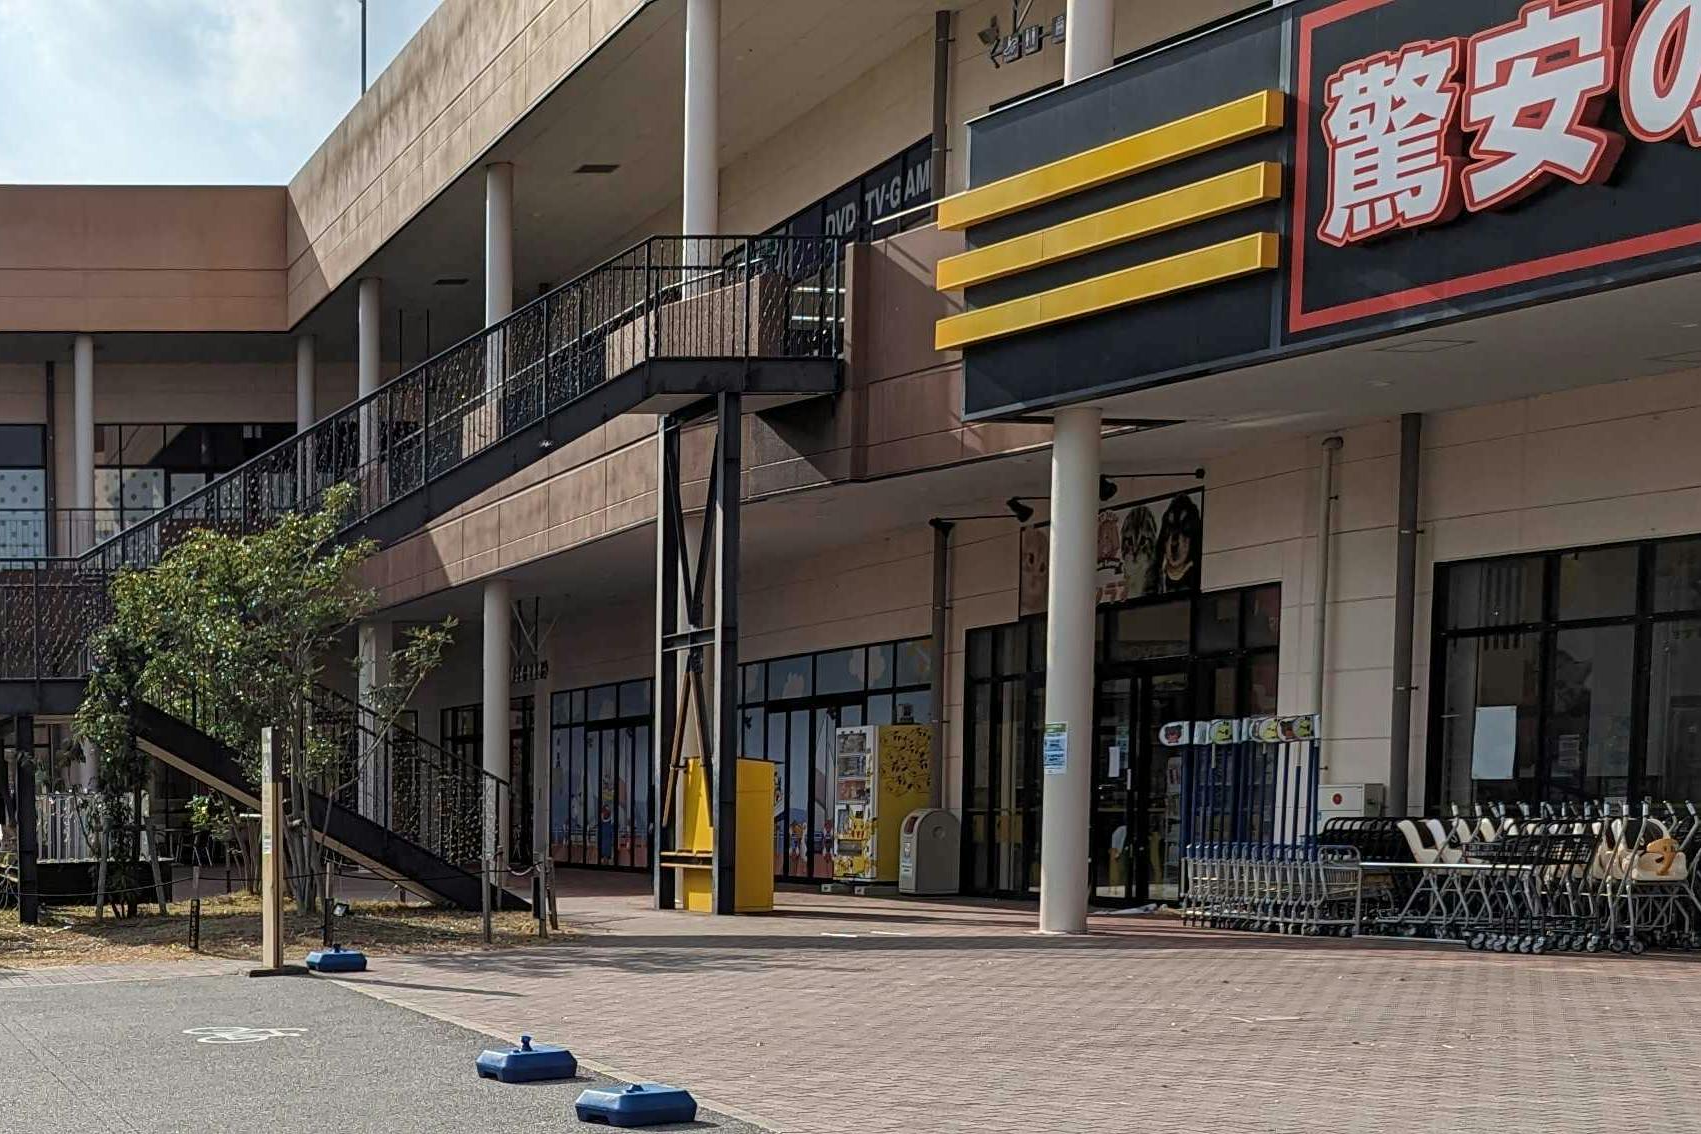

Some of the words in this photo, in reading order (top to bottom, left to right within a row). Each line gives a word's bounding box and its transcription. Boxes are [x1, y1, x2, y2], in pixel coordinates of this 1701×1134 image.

[825, 202, 856, 241] DVD
[864, 159, 931, 220] TV-GAM
[1316, 0, 1701, 247] 驚安の
